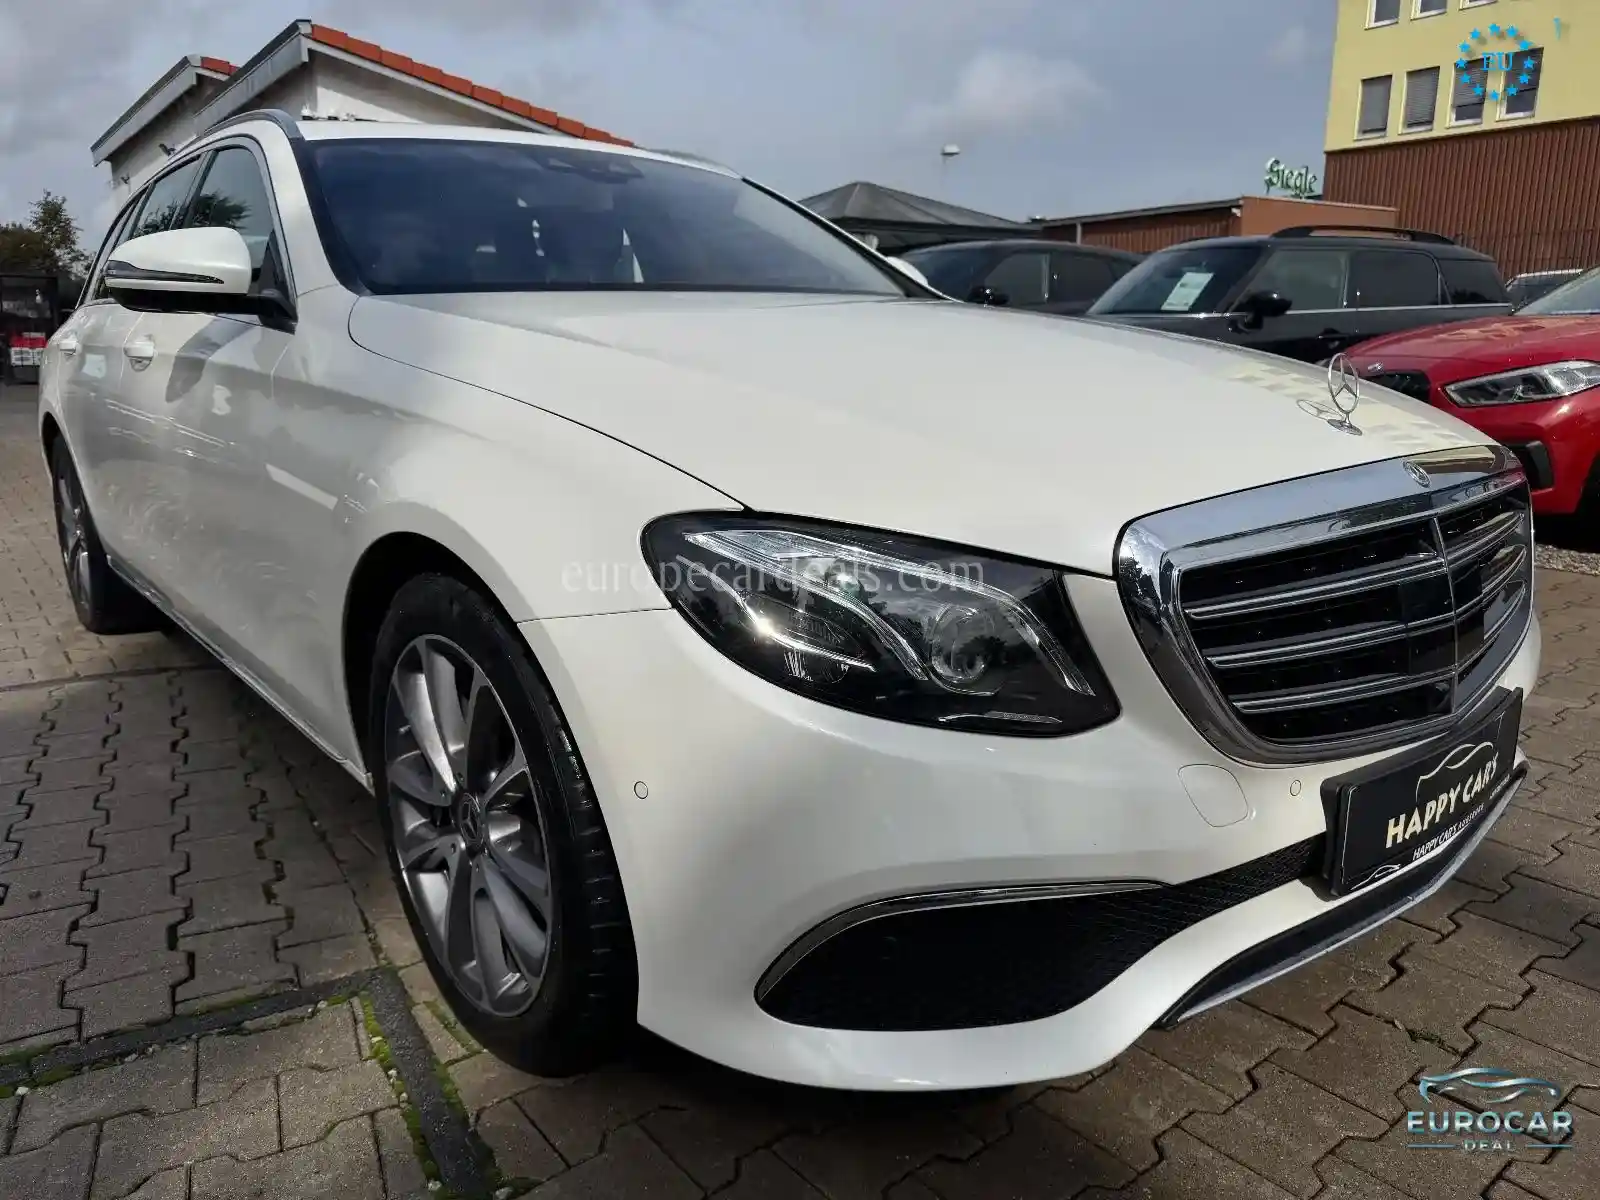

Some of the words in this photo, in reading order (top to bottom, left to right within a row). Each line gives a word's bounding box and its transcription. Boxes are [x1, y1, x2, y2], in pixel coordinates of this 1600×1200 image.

[1264, 157, 1317, 195] Siegle
[1385, 783, 1461, 848] HAPPY
[1462, 752, 1499, 803] CARS
